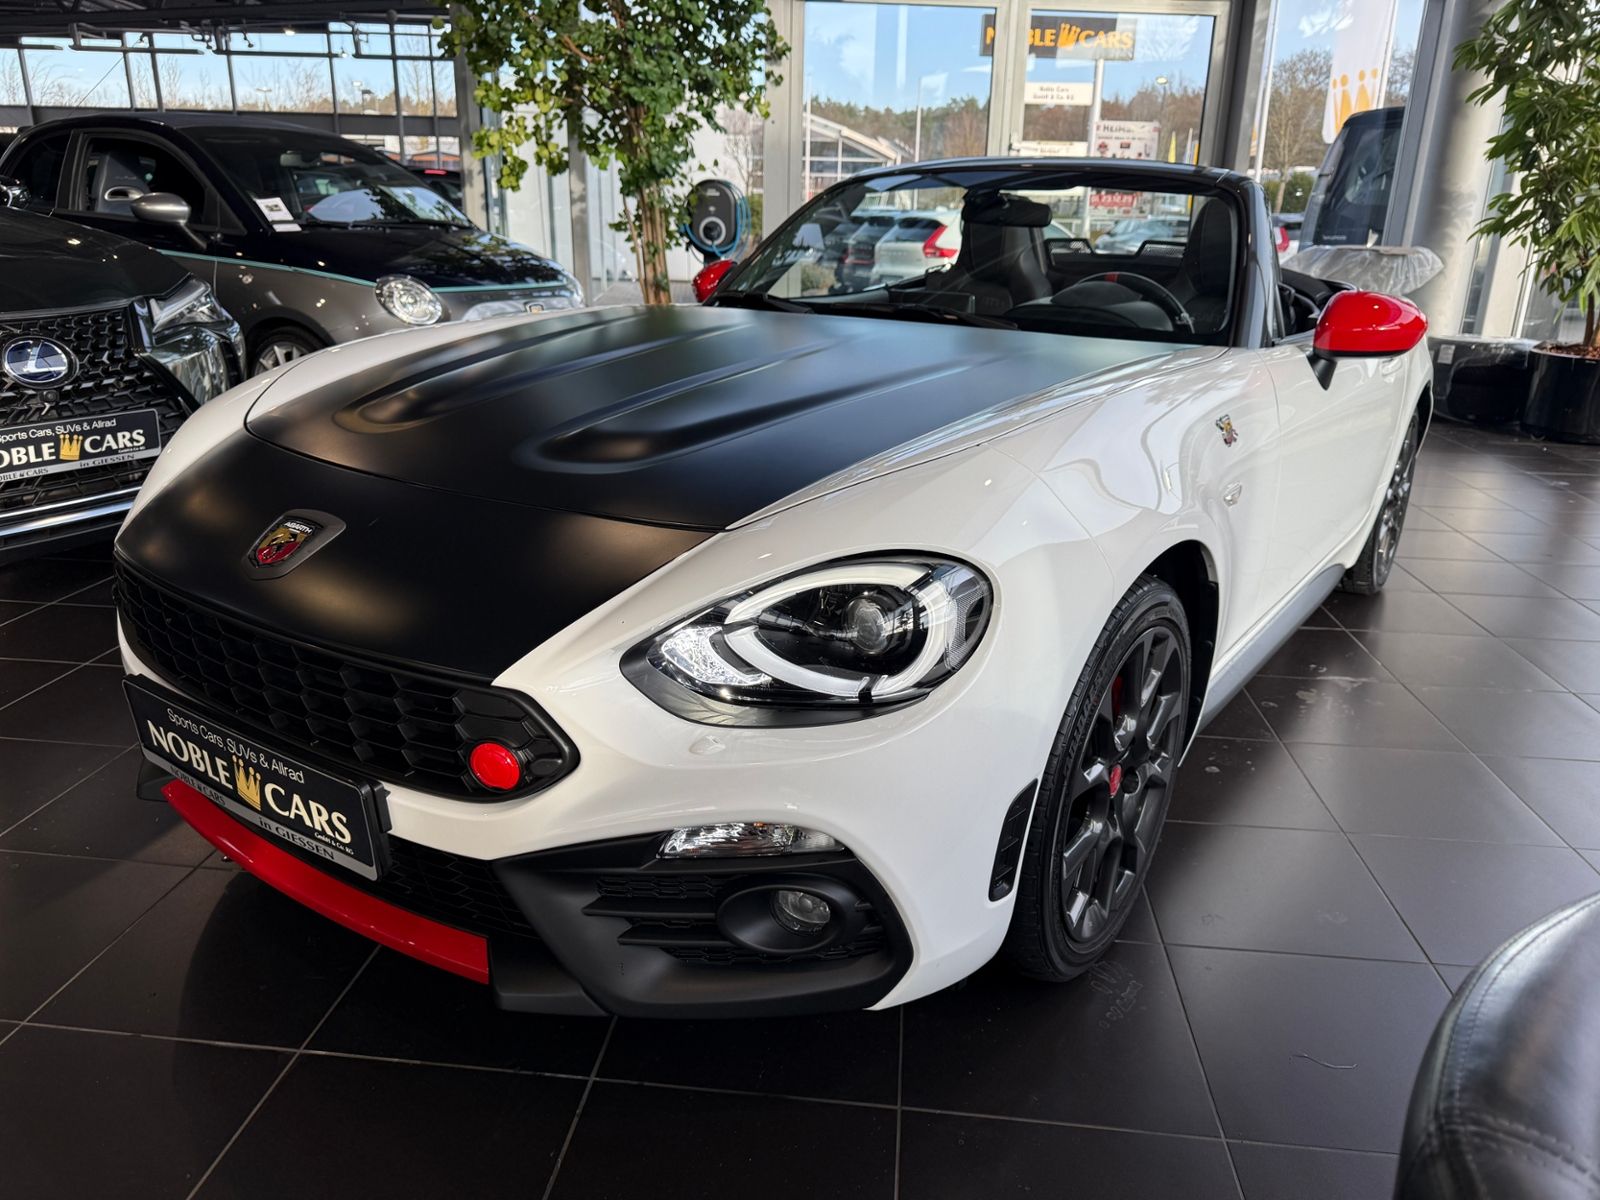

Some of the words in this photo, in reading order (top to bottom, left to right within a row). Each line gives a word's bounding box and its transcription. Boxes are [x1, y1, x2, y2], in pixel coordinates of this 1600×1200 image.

[986, 26, 1057, 48] NBLE
[1079, 29, 1133, 49] CARS
[0, 431, 28, 444] ports
[29, 428, 55, 440] Cars,
[55, 423, 82, 435] SUVs
[83, 422, 91, 431] &
[91, 417, 117, 430] Allrad
[84, 429, 146, 454] CARS
[26, 468, 49, 477] CARS
[79, 460, 90, 468] in
[92, 454, 135, 467] GIESSEN
[283, 521, 313, 534] ABARTH
[167, 708, 199, 735] Sports
[200, 725, 227, 751] Cars,
[226, 738, 258, 763] SUVs
[259, 753, 270, 769] &
[271, 759, 305, 784] Allrad
[146, 719, 233, 790] NOBLE
[264, 783, 352, 844] CARS
[202, 787, 226, 806] CARS
[259, 817, 272, 829] in
[275, 825, 335, 860] GIESSEN
